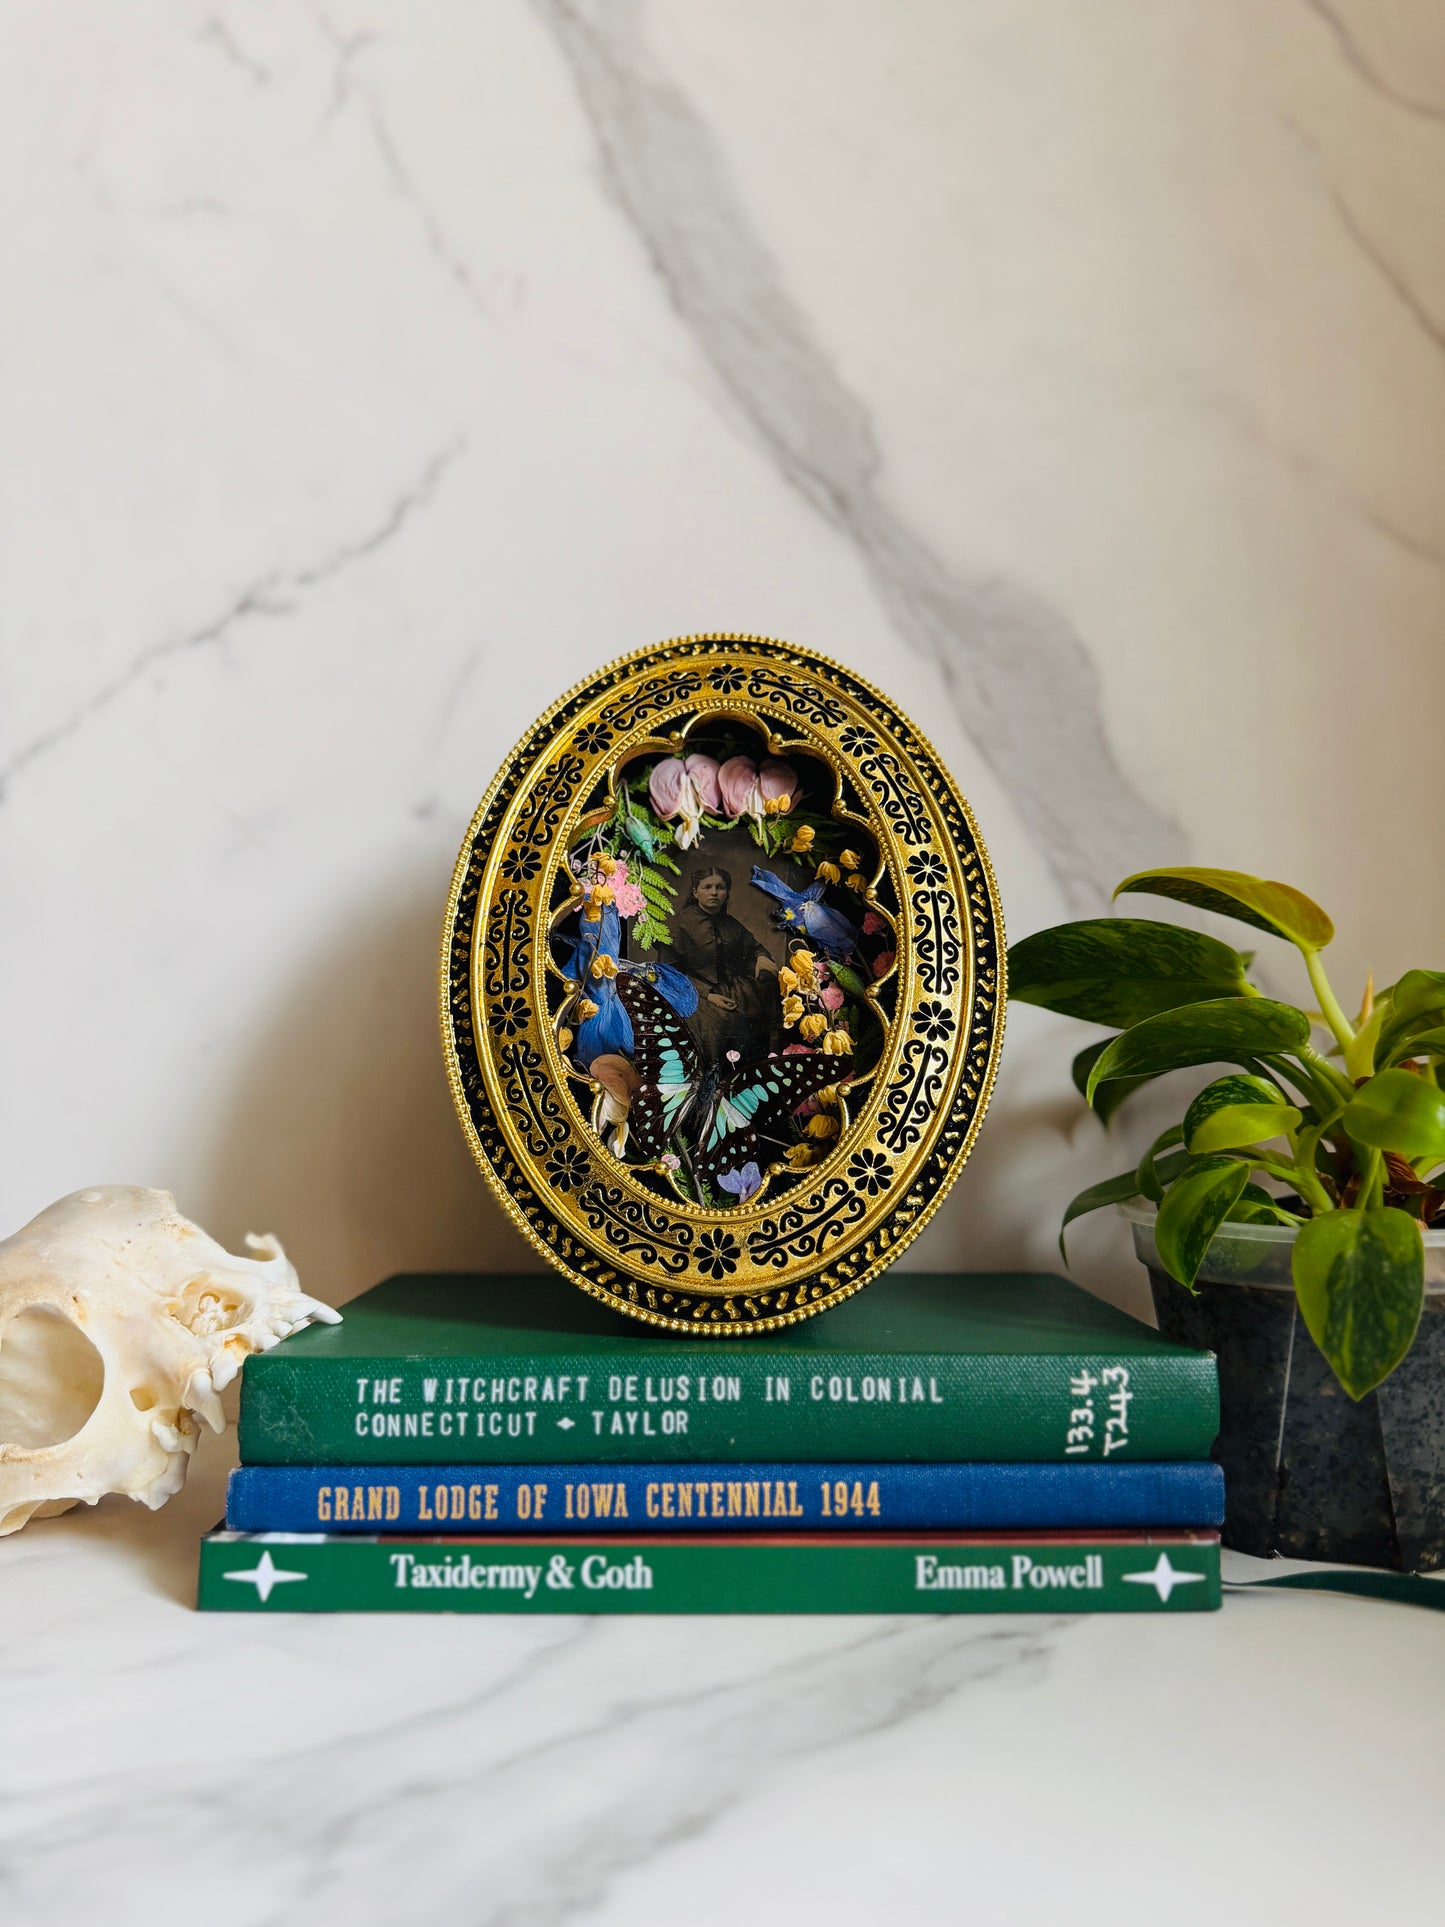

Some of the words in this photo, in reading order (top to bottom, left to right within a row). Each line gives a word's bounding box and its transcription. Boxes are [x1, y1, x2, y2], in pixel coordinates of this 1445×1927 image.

[357, 1378, 402, 1404] THE
[423, 1376, 589, 1403] WITCHCRAFT
[608, 1375, 741, 1402] DELUSION
[766, 1376, 790, 1402] IN
[811, 1375, 943, 1403] COLONIAL
[355, 1412, 537, 1437] CONNECTICUT
[592, 1410, 689, 1435] TAYLOR
[1064, 1369, 1098, 1454] 133.4
[1102, 1366, 1134, 1457] T243
[317, 1486, 402, 1521] GRAND
[417, 1484, 499, 1521] LODGE
[516, 1483, 548, 1520] OF
[564, 1482, 629, 1519] IOWA
[645, 1481, 804, 1519] CENTENNIAL
[820, 1481, 882, 1517] 1944
[390, 1554, 541, 1598] Taxidermy
[545, 1555, 576, 1590] &
[580, 1554, 654, 1590] Goth
[914, 1555, 1006, 1590] Emma
[1010, 1554, 1104, 1589] Powell
